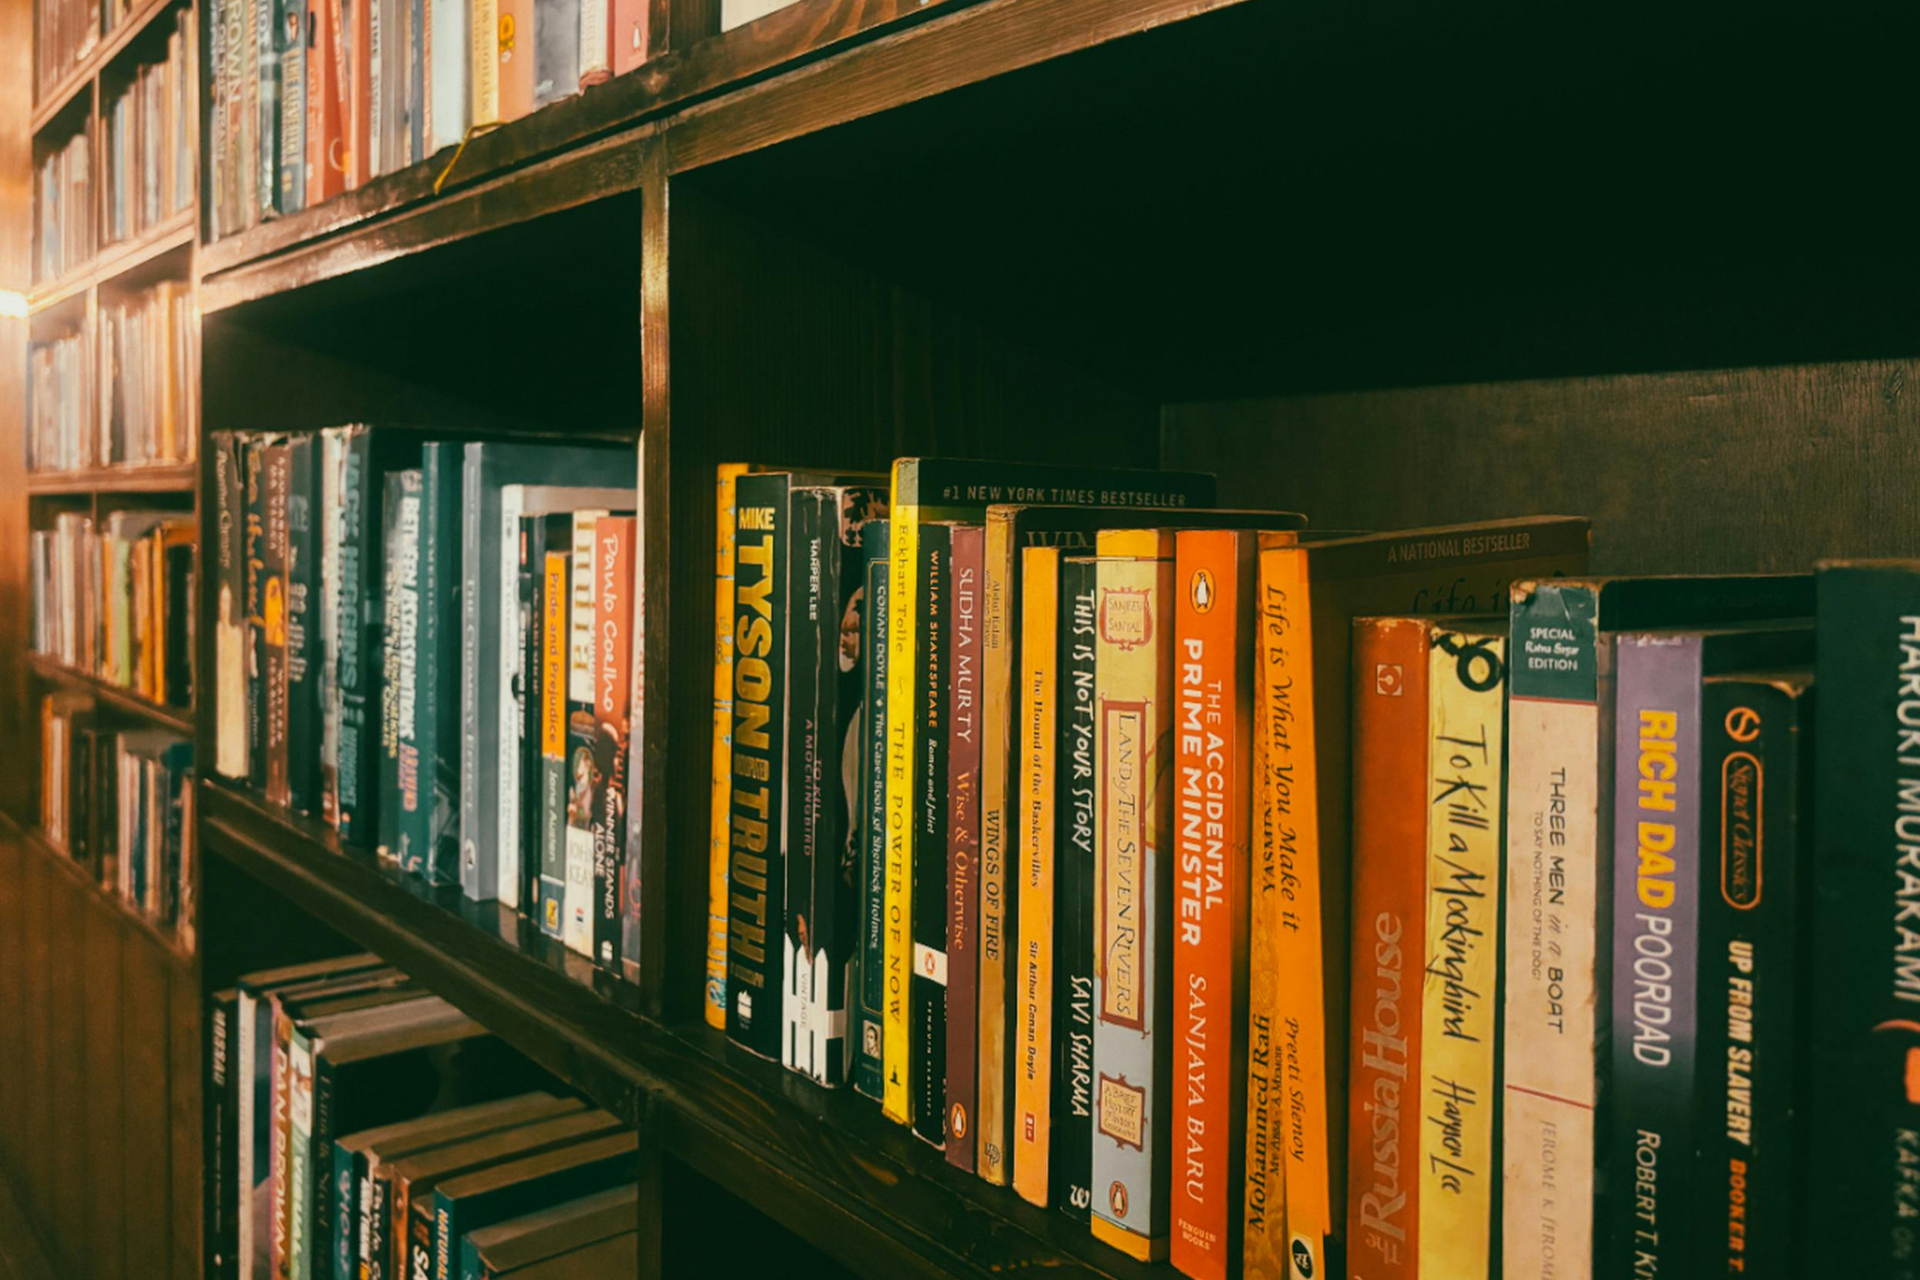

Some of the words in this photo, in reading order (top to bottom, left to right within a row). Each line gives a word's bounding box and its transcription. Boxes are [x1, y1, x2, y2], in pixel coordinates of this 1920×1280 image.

[227, 0, 242, 101] ROWN
[738, 506, 776, 531] MIKE
[943, 487, 960, 499] #1
[967, 486, 1001, 501] NEW
[1007, 487, 1045, 502] YORK
[1051, 489, 1095, 504] TIMES
[1101, 490, 1186, 507] BESTSELLER
[602, 533, 619, 613] Paulo
[810, 538, 819, 593] HARPER
[896, 525, 909, 597] Eckhart
[1388, 548, 1397, 563] A
[1400, 540, 1460, 561] NATIONAL
[1463, 532, 1531, 556] BESTSELLER
[550, 572, 560, 618] Pride
[809, 597, 818, 621] LEE
[928, 550, 939, 616] WILLIAM
[958, 567, 974, 648] SUDHA
[1108, 598, 1143, 613] SANJEEV
[1266, 584, 1289, 636] Life
[342, 546, 359, 688] HIGGINS
[876, 586, 886, 637] CONAN
[895, 603, 908, 653] Tolle
[1073, 589, 1096, 635] THIS
[1108, 617, 1143, 634] SANYAL
[1529, 627, 1576, 641] SPECIAL
[550, 624, 559, 657] and
[602, 619, 618, 713] Coelho
[735, 534, 774, 750] TYSON
[875, 643, 885, 688] DOYLE
[1073, 643, 1095, 663] IS
[1269, 650, 1285, 667] is
[1528, 656, 1579, 671] EDITION
[547, 661, 560, 742] Prejudice
[927, 621, 938, 728] SHAKESPEARE
[957, 654, 973, 743] MURTY
[1034, 670, 1043, 698] The
[1072, 670, 1095, 721] NOT
[1182, 638, 1204, 755] PRIME
[1896, 615, 1920, 765] HARUKI
[875, 712, 884, 737] The
[1032, 702, 1043, 749] Hound
[1206, 680, 1223, 725] THE
[1270, 674, 1296, 751] What
[893, 724, 907, 781] THE
[927, 738, 938, 773] Romeo
[1072, 723, 1094, 780] YOUR
[1118, 712, 1137, 778] LAND
[1435, 724, 1489, 770] To
[1638, 709, 1678, 813] RICH
[548, 769, 559, 806] Jane
[803, 735, 813, 856] MOCKINGBIRD
[813, 780, 823, 819] KILL
[872, 741, 884, 813] Case-Book
[954, 771, 971, 822] Wise
[1032, 768, 1042, 797] the
[1273, 760, 1297, 815] You
[1433, 775, 1490, 831] Kill
[605, 786, 617, 853] WINNER
[923, 796, 937, 834] Juliet
[1071, 786, 1093, 853] STORY
[1118, 794, 1136, 836] THE
[1205, 732, 1224, 910] ACCIDENTAL
[1534, 811, 1544, 826] TO
[1548, 766, 1567, 848] THREE
[548, 811, 558, 862] Austen
[594, 822, 605, 878] ALONE
[889, 794, 904, 896] POWER
[954, 827, 969, 843] &
[985, 808, 1000, 875] WINGS
[1031, 800, 1042, 888] Baskervilles
[1180, 767, 1203, 946] MINISTER
[1448, 833, 1469, 853] a
[1533, 828, 1544, 849] SAY
[605, 860, 615, 920] STANDS
[731, 787, 770, 962] TRUTH
[871, 836, 882, 894] Sherlock
[1116, 836, 1136, 922] SEVEN
[1277, 825, 1302, 902] Make
[1532, 851, 1543, 906] NOTHING
[1547, 854, 1566, 907] MEN
[1636, 821, 1677, 909] DAD
[1894, 777, 1920, 1003] MURAKAMI
[953, 851, 969, 950] Otherwise
[985, 881, 999, 908] OF
[1281, 909, 1301, 934] it
[1532, 908, 1542, 924] OF
[869, 898, 880, 949] Holmes
[889, 904, 902, 945] OF
[984, 912, 999, 961] FIRE
[1029, 940, 1038, 959] Sir
[1425, 853, 1487, 1045] Mockingbird
[1531, 926, 1541, 947] THE
[1028, 962, 1038, 1001] Arthur
[1107, 922, 1136, 1016] RIVERS
[1728, 939, 1753, 974] UP
[889, 954, 901, 1025] NOW
[1070, 974, 1093, 1025] SAVI
[1546, 965, 1564, 1035] BOAT
[1727, 976, 1753, 1043] FROM
[213, 1008, 227, 1086] MOSSAD
[1027, 1003, 1037, 1040] Conan
[1185, 972, 1207, 1107] SANJAYA
[1252, 1013, 1271, 1068] Rafi
[1026, 1043, 1037, 1081] Doyle
[1070, 1030, 1092, 1118] SHARMA
[1284, 1017, 1302, 1083] Preeti
[275, 1048, 288, 1121] DAN
[1726, 1045, 1753, 1146] SLAVERY
[1288, 1087, 1307, 1162] Shenoy
[1185, 1115, 1206, 1204] BARU
[1248, 1072, 1270, 1233] Mohammed
[1430, 1153, 1476, 1195] Lee
[1541, 1118, 1557, 1190] JEROME
[1635, 1128, 1661, 1225] ROBERT
[1893, 1128, 1920, 1218] KAFKA
[274, 1128, 287, 1257] BROWN
[1728, 1157, 1747, 1251] BOOKER
[437, 1208, 449, 1280] NATURAL
[1178, 1218, 1217, 1243] PENGUIN
[1182, 1230, 1211, 1250] BOOKS
[1364, 1232, 1402, 1266] The
[1635, 1230, 1658, 1246] T.
